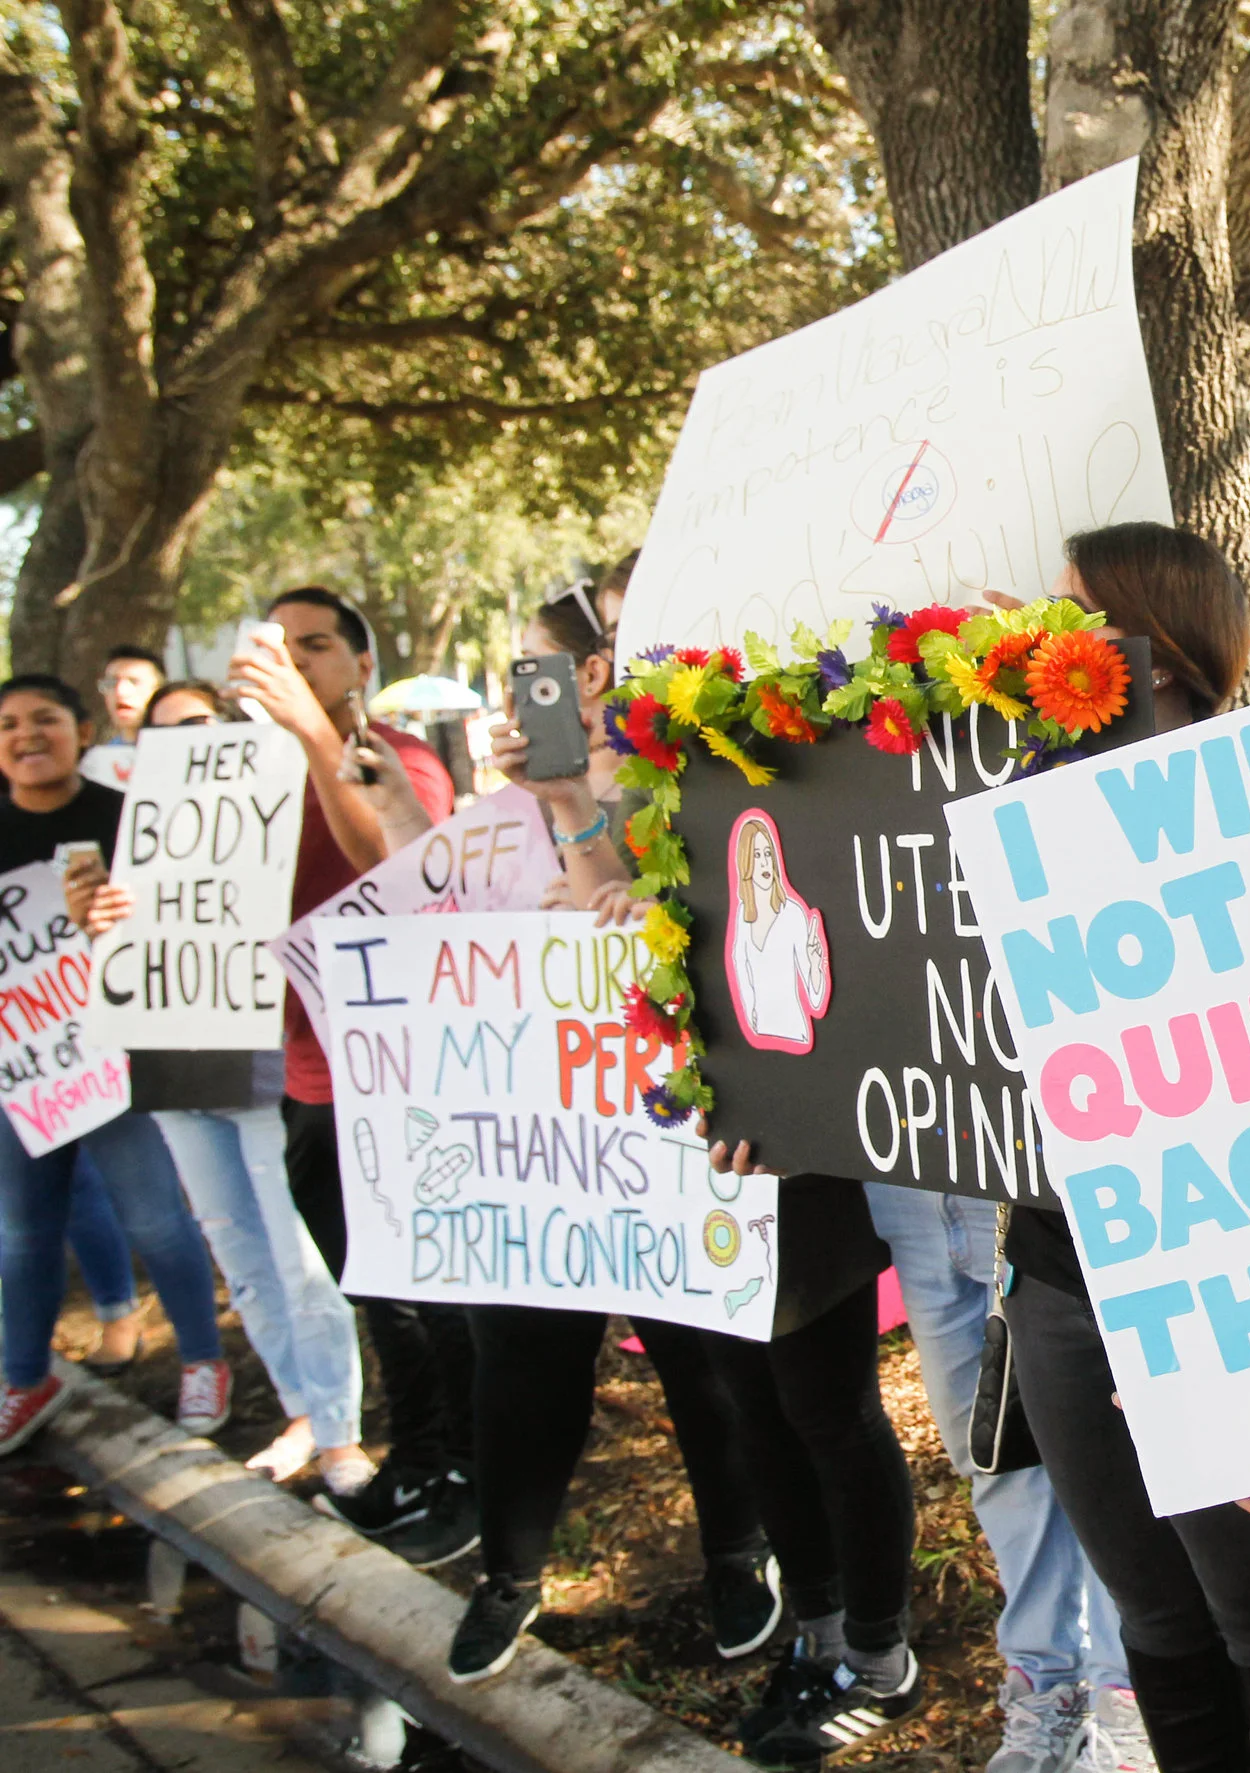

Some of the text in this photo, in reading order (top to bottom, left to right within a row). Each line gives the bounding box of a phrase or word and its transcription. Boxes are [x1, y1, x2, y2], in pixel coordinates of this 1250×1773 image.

[681, 347, 1063, 537] impotence is
[184, 739, 258, 784] HER
[911, 700, 1017, 792] NO
[420, 821, 523, 896] OFF
[854, 834, 982, 938] UTE
[992, 799, 1050, 903] I
[155, 878, 241, 928] HER
[1001, 860, 1247, 1029] NOT
[101, 940, 277, 1012] CHOICE
[335, 938, 408, 1007] I
[428, 939, 522, 1009] AM
[344, 1026, 412, 1096] ON
[434, 1013, 532, 1097] MY
[451, 1111, 650, 1201] THANKS
[857, 1066, 1040, 1200] OPINI
[412, 1203, 712, 1297] BIRTH CONTROL
